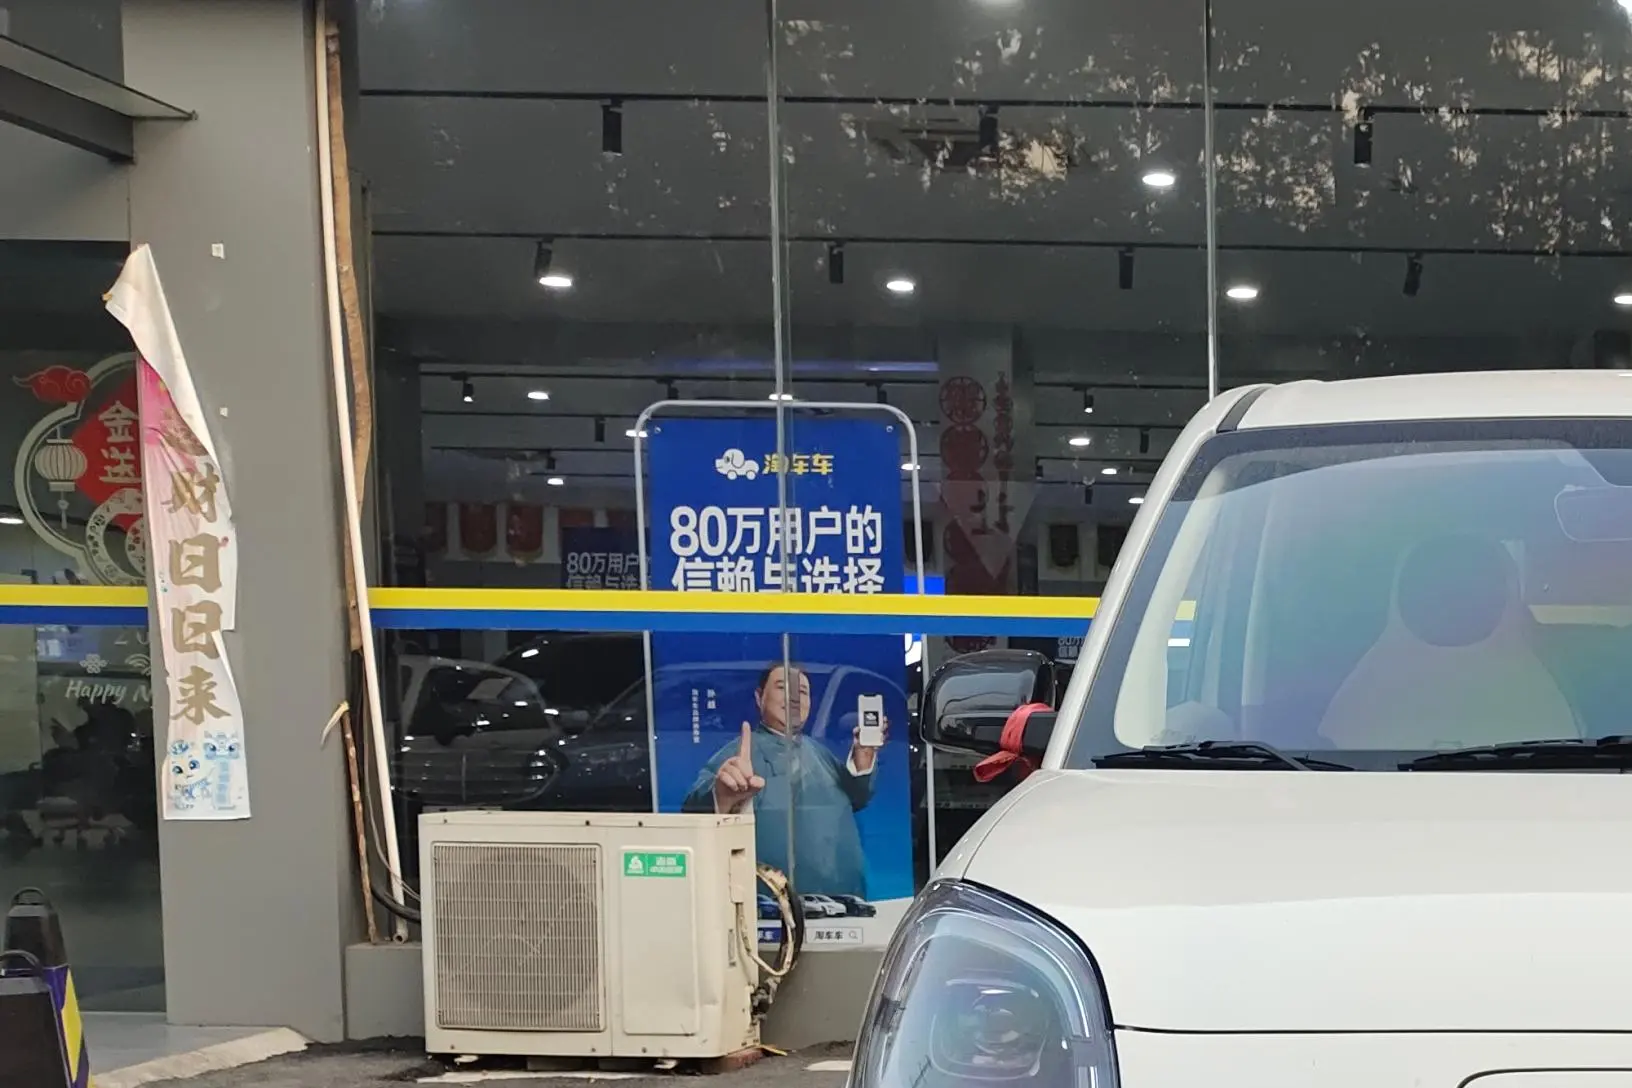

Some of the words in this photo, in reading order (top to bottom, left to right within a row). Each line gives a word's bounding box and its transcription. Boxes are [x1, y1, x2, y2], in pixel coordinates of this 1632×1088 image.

[762, 453, 834, 476] 淘车车
[670, 505, 883, 557] 80万用户的
[65, 679, 128, 705] Happy
